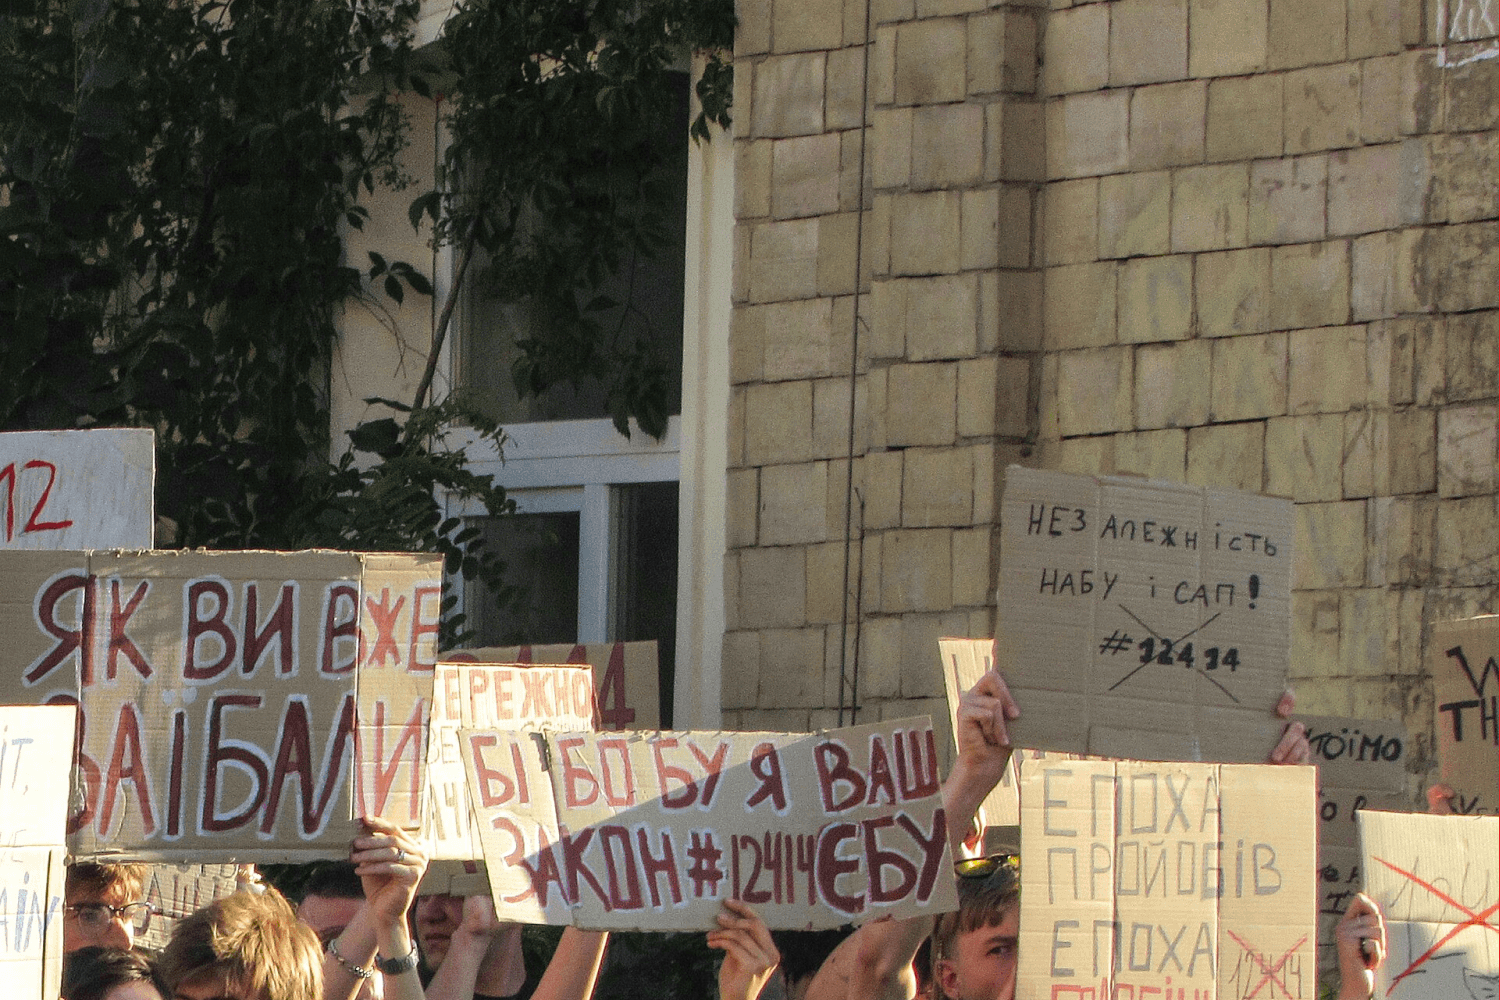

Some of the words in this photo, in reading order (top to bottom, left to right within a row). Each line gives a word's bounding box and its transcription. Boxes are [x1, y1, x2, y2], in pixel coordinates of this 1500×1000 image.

[1040, 569, 1118, 600] НАБУ
[23, 571, 154, 686] ЯК
[183, 577, 296, 680] ВИ
[320, 584, 441, 677] ВЖЕ
[1100, 630, 1240, 672] #12414
[745, 741, 787, 812] Я
[814, 727, 940, 814] ВАШ
[1042, 768, 1226, 838] ЕПОХА
[1050, 919, 1217, 978] ЕПОХА
